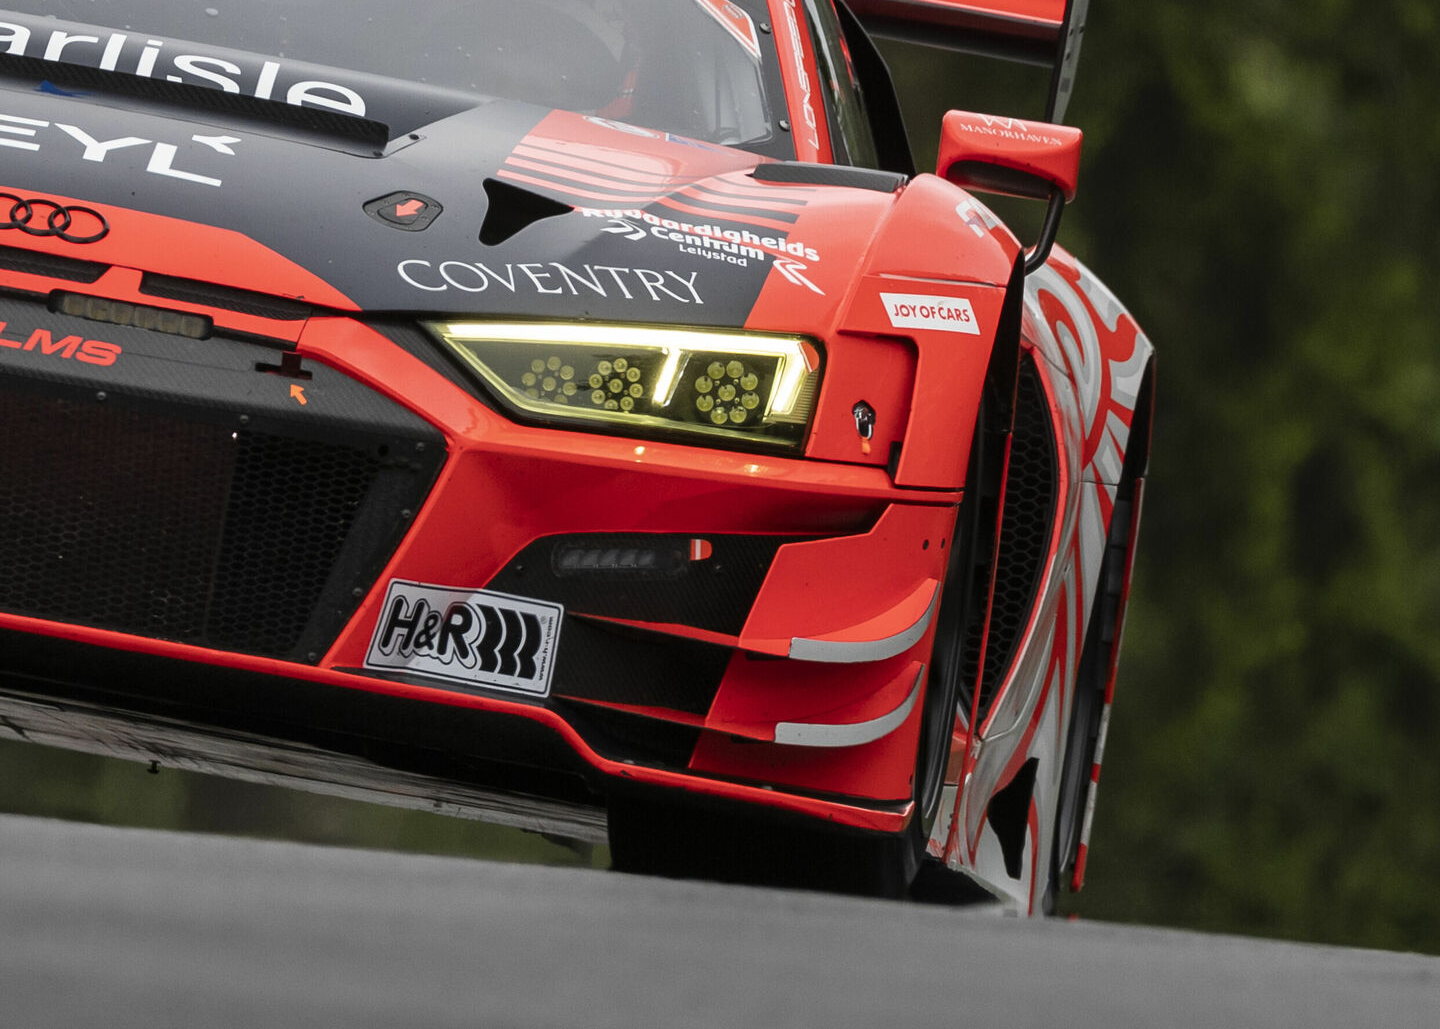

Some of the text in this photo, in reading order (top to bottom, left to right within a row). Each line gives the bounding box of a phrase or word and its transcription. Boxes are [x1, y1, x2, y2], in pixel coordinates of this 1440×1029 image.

[960, 123, 1062, 146] MANORHAVEN
[651, 222, 765, 262] Centrum
[679, 243, 748, 268] Lelystad
[397, 258, 705, 305] COVENTRY
[894, 304, 971, 323] JOY OF CARS
[379, 595, 482, 669] H&R
